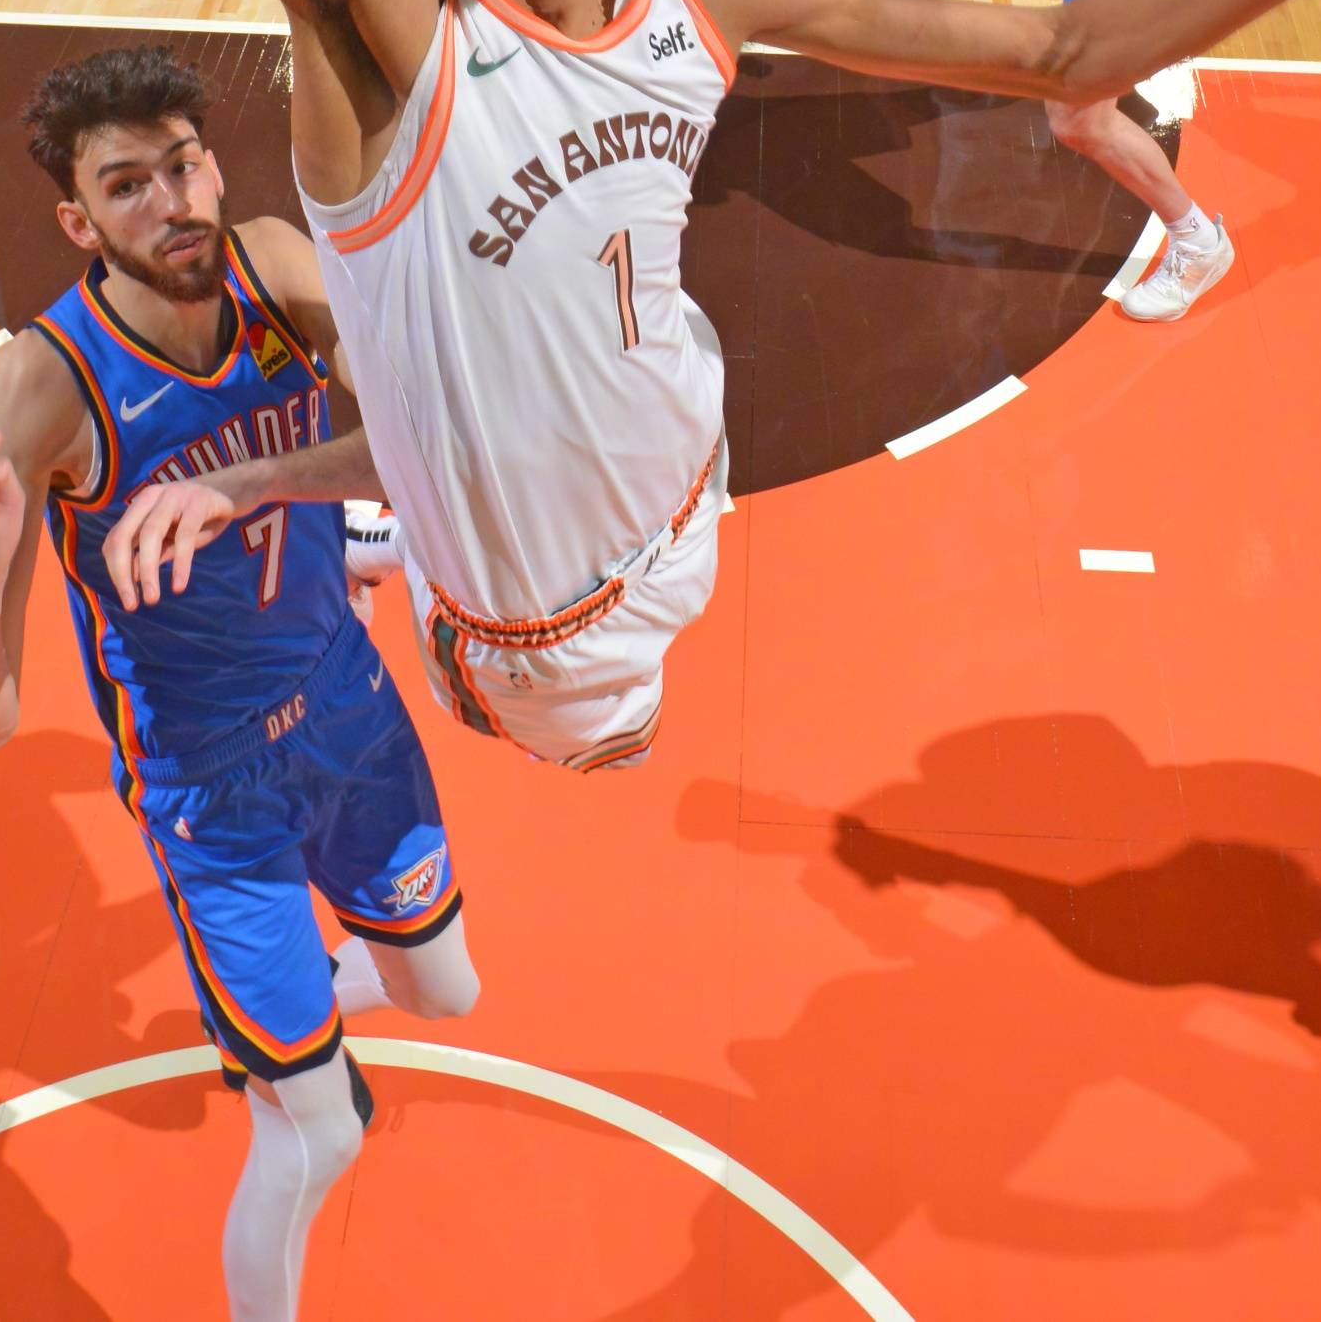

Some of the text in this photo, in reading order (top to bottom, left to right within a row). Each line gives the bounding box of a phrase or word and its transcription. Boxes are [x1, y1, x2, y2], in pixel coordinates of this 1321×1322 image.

[648, 22, 695, 62] Self.
[468, 110, 706, 268] SAN ANTONI
[596, 227, 641, 353] 1
[125, 384, 322, 508] UNDER
[240, 500, 289, 611] 7
[264, 692, 307, 743] OKC
[400, 858, 436, 908] OKC
